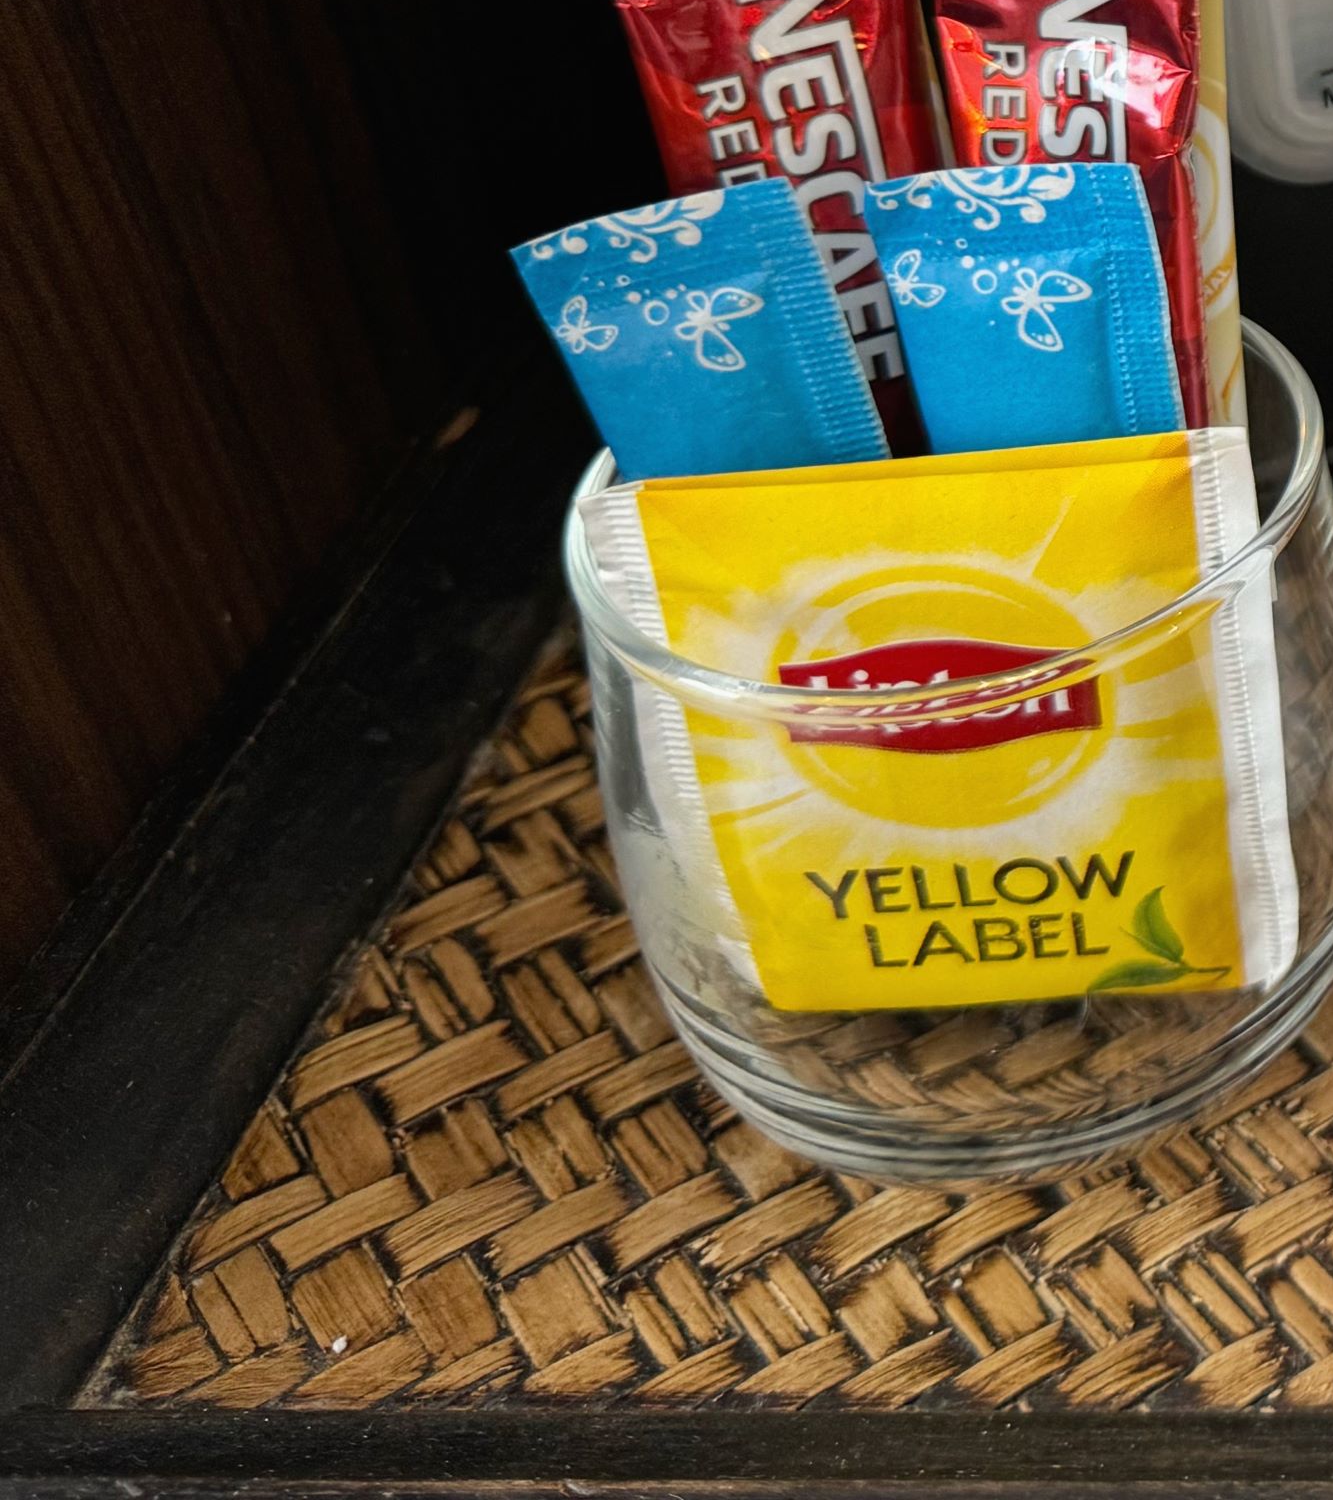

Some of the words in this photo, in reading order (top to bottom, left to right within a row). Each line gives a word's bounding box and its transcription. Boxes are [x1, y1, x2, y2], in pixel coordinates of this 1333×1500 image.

[983, 42, 1028, 165] RED
[804, 850, 1135, 920] YELLOW
[863, 911, 1112, 968] LABEL
